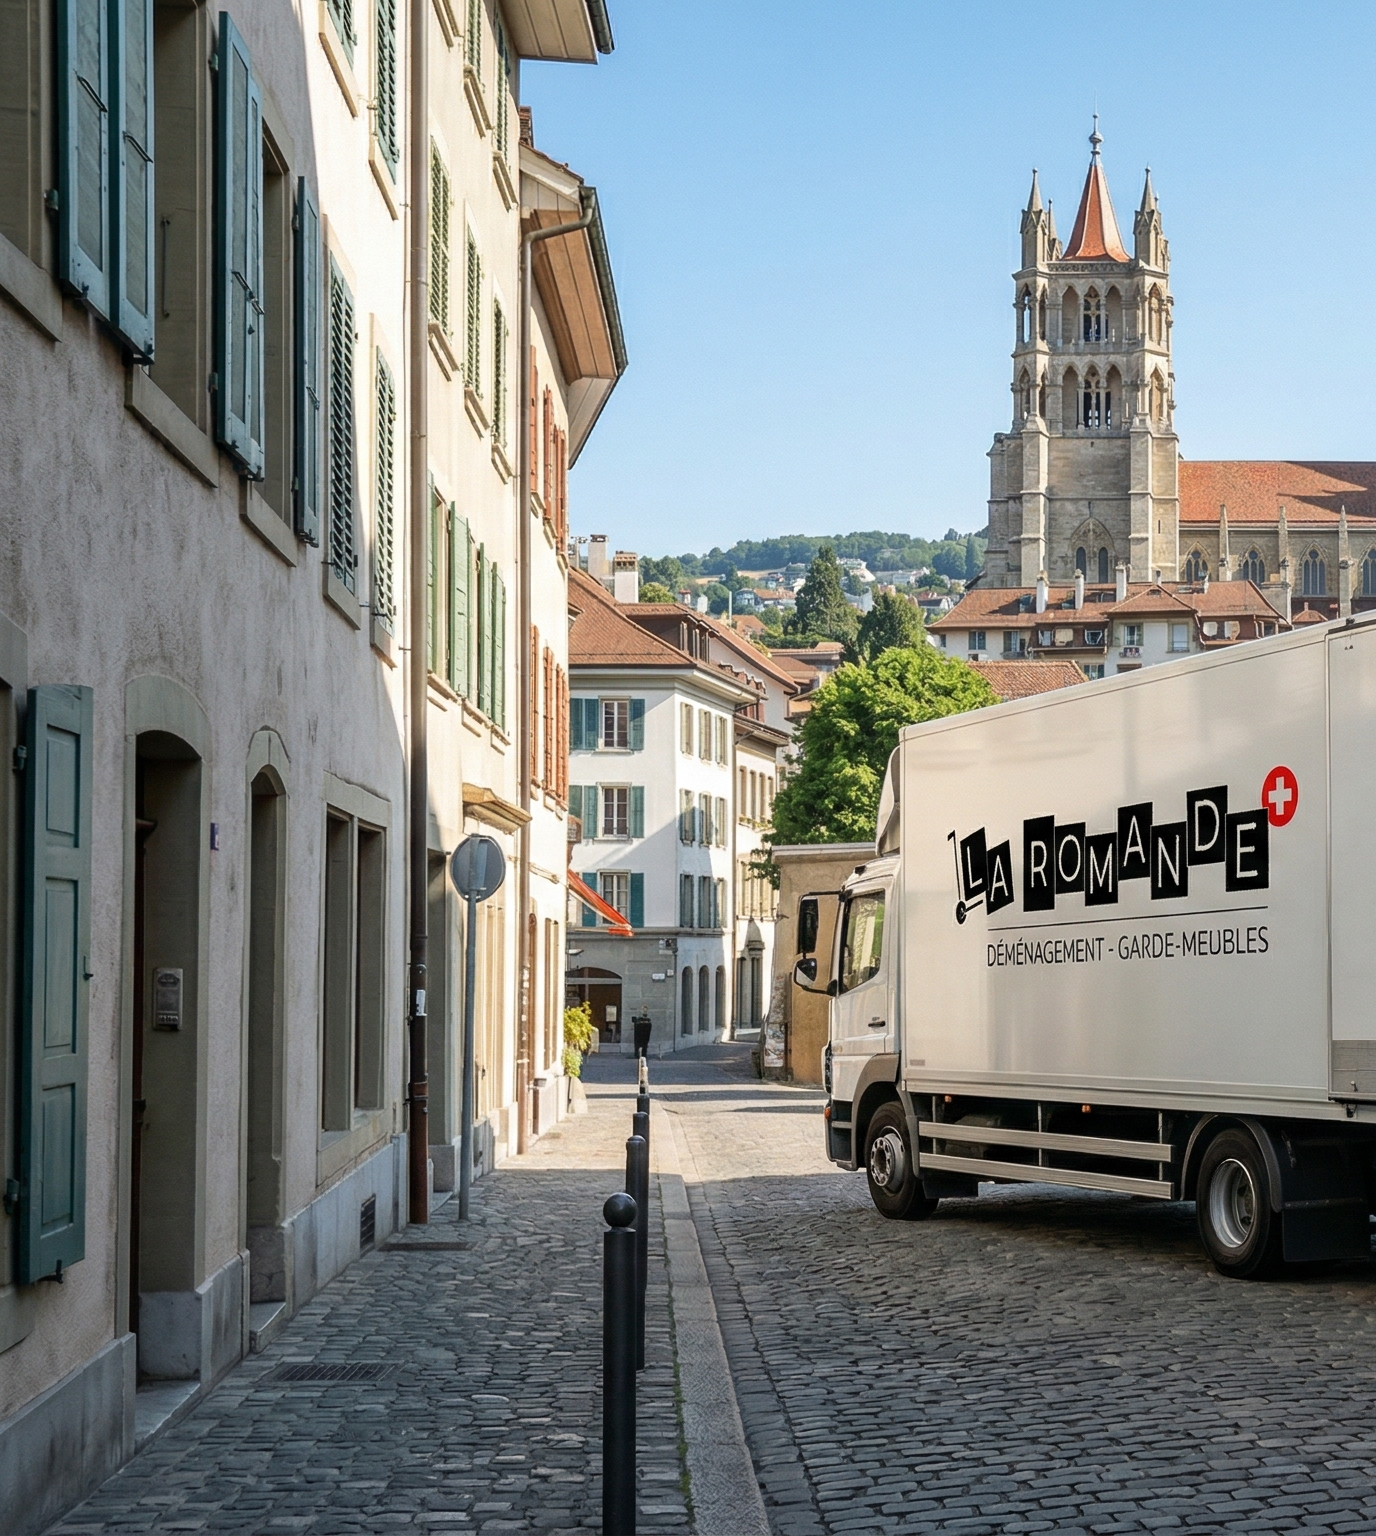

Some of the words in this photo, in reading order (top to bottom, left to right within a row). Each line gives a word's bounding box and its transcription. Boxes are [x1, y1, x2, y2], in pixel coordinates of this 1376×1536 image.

[965, 843, 1010, 903] LA
[1030, 798, 1259, 895] ROMANDE
[987, 937, 1105, 967] DÉMÉNAGEMENT
[1118, 926, 1269, 960] GARDE-MEUBLES
